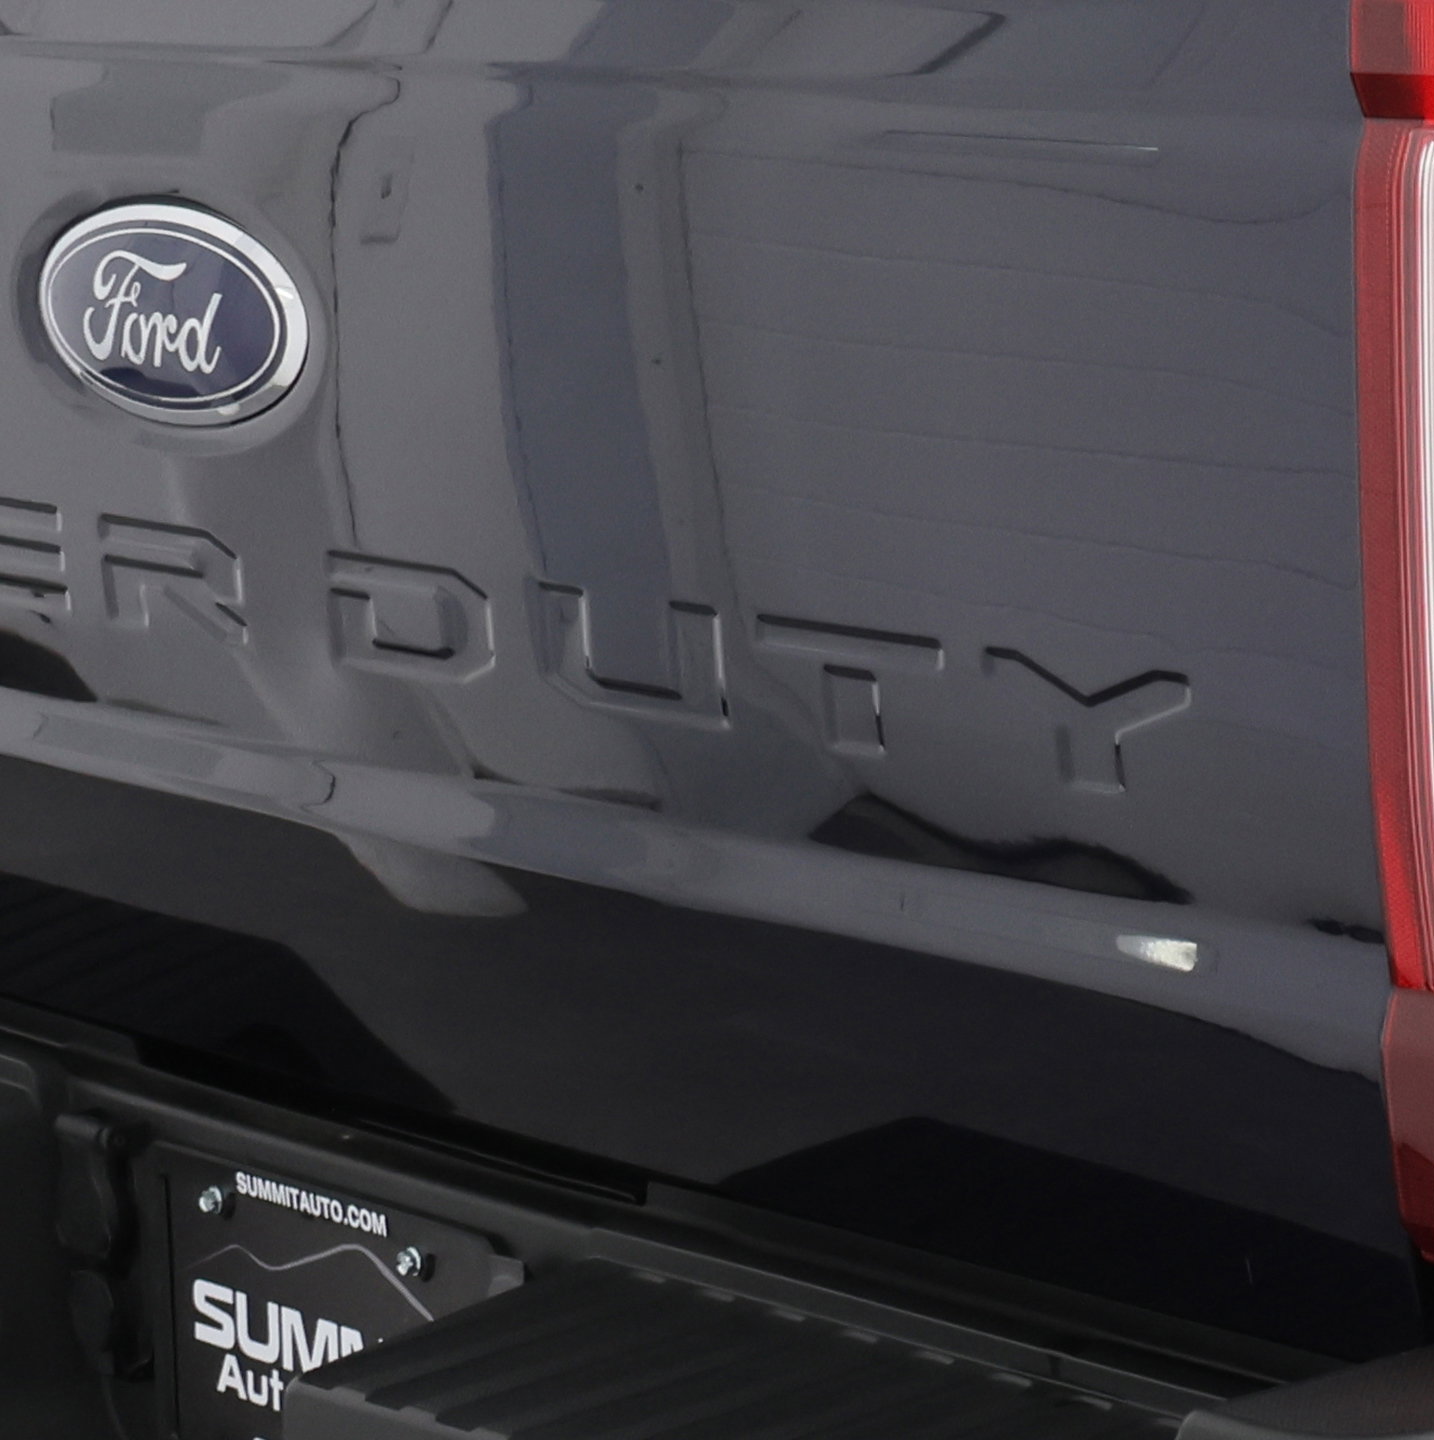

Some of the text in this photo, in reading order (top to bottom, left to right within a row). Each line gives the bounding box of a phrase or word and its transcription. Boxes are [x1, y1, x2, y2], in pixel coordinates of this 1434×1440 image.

[81, 249, 222, 374] Ford
[325, 548, 1192, 794] DUTY
[235, 1170, 389, 1239] SUMMITAUTO.COM
